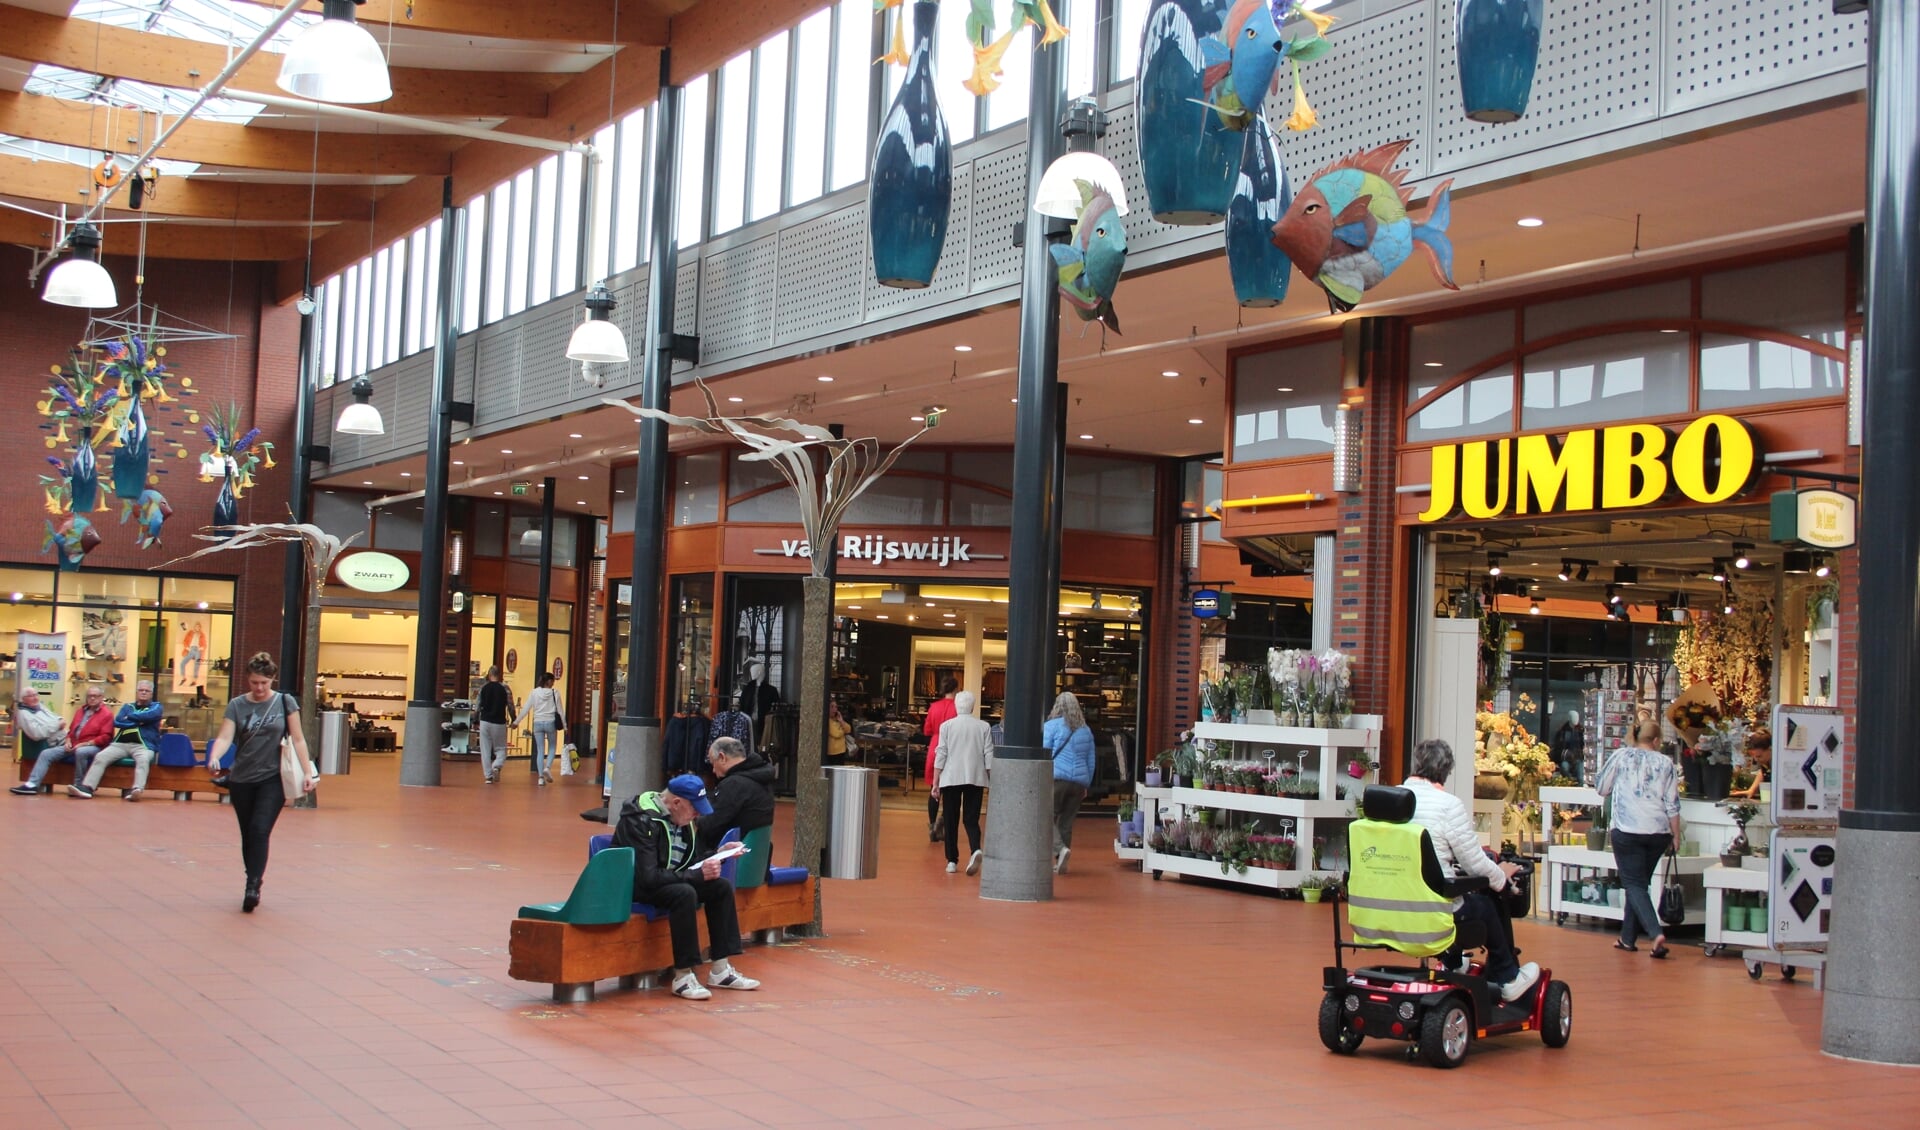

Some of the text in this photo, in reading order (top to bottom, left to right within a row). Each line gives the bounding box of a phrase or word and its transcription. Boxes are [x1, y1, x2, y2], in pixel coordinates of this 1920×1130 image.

[1418, 414, 1754, 522] JUMBO
[781, 535, 970, 566] va Rijswijk
[354, 571, 395, 579] ZWART
[28, 657, 48, 670] Pia
[30, 669, 60, 680] Zaza
[31, 681, 55, 689] POST
[1780, 920, 1790, 931] 21
